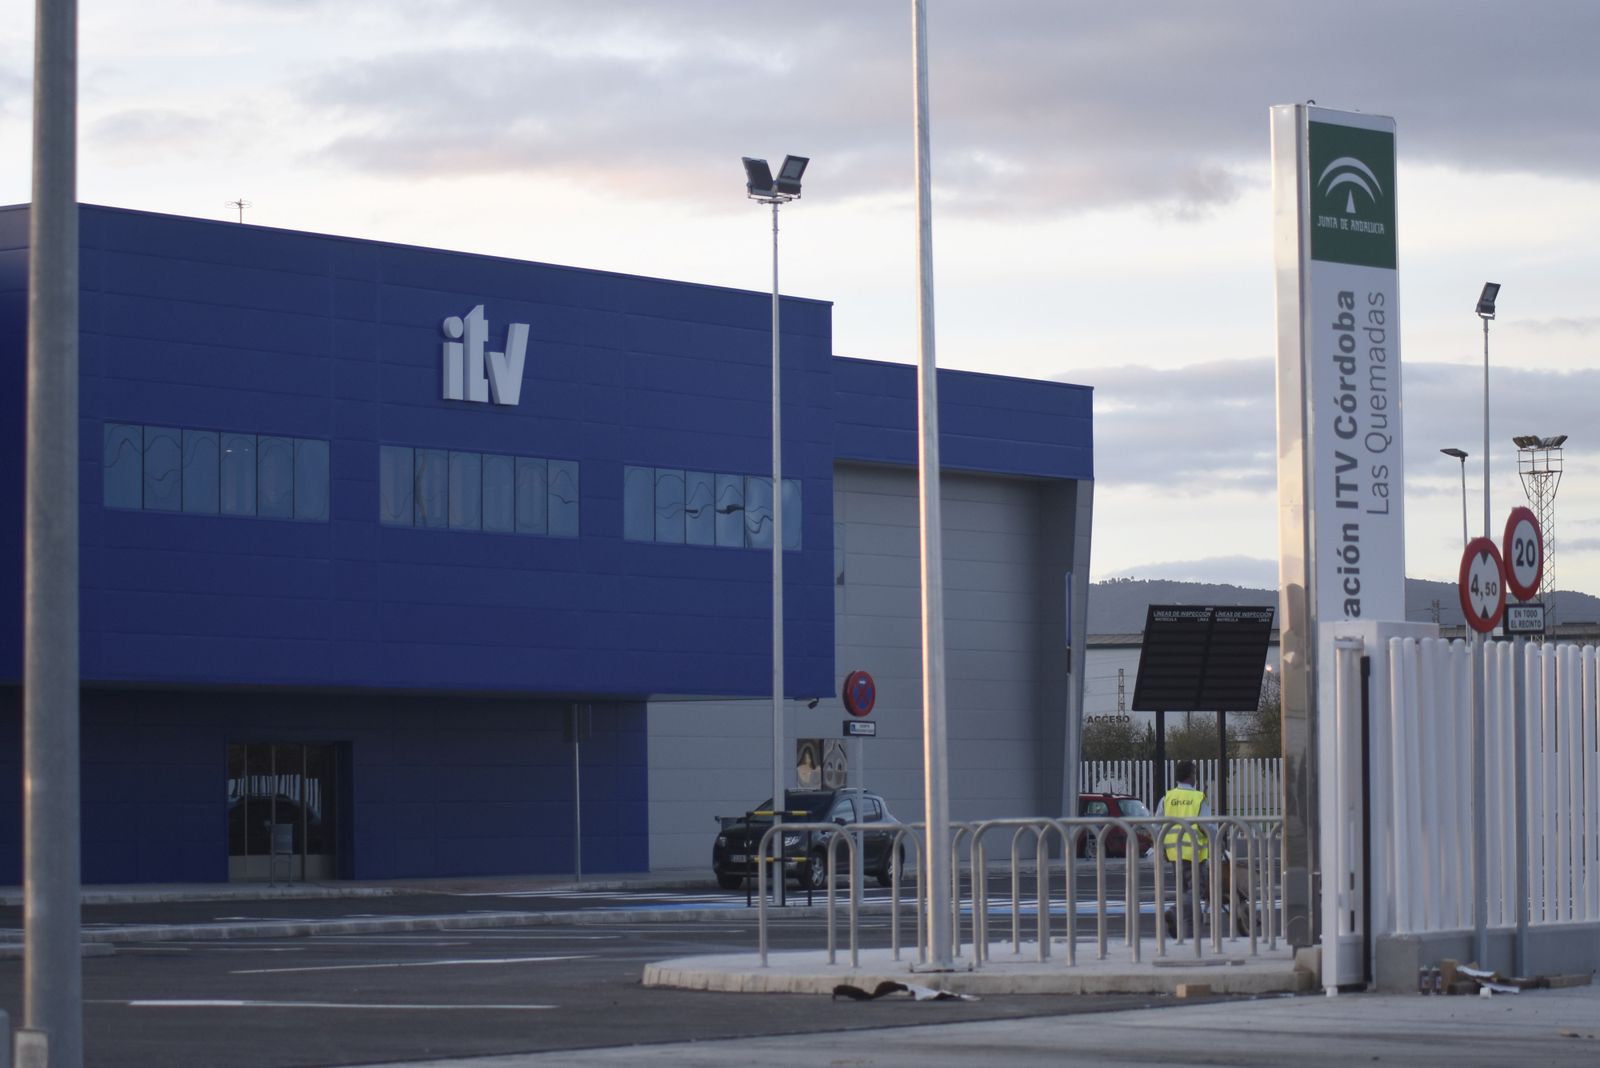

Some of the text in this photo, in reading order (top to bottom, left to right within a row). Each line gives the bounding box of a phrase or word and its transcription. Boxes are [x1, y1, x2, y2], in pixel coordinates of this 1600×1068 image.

[1317, 215, 1338, 229] JUNTA
[1340, 218, 1349, 231] DE
[443, 304, 530, 406] itv
[1362, 292, 1393, 515] Las Quemadas
[1332, 290, 1361, 622] ación ITV Córdoba
[1515, 538, 1536, 568] 20
[1470, 573, 1497, 600] 4,50
[1510, 620, 1542, 629] EL RECINTO
[1514, 609, 1538, 618] EN TODO
[1087, 715, 1130, 724] ACCESO
